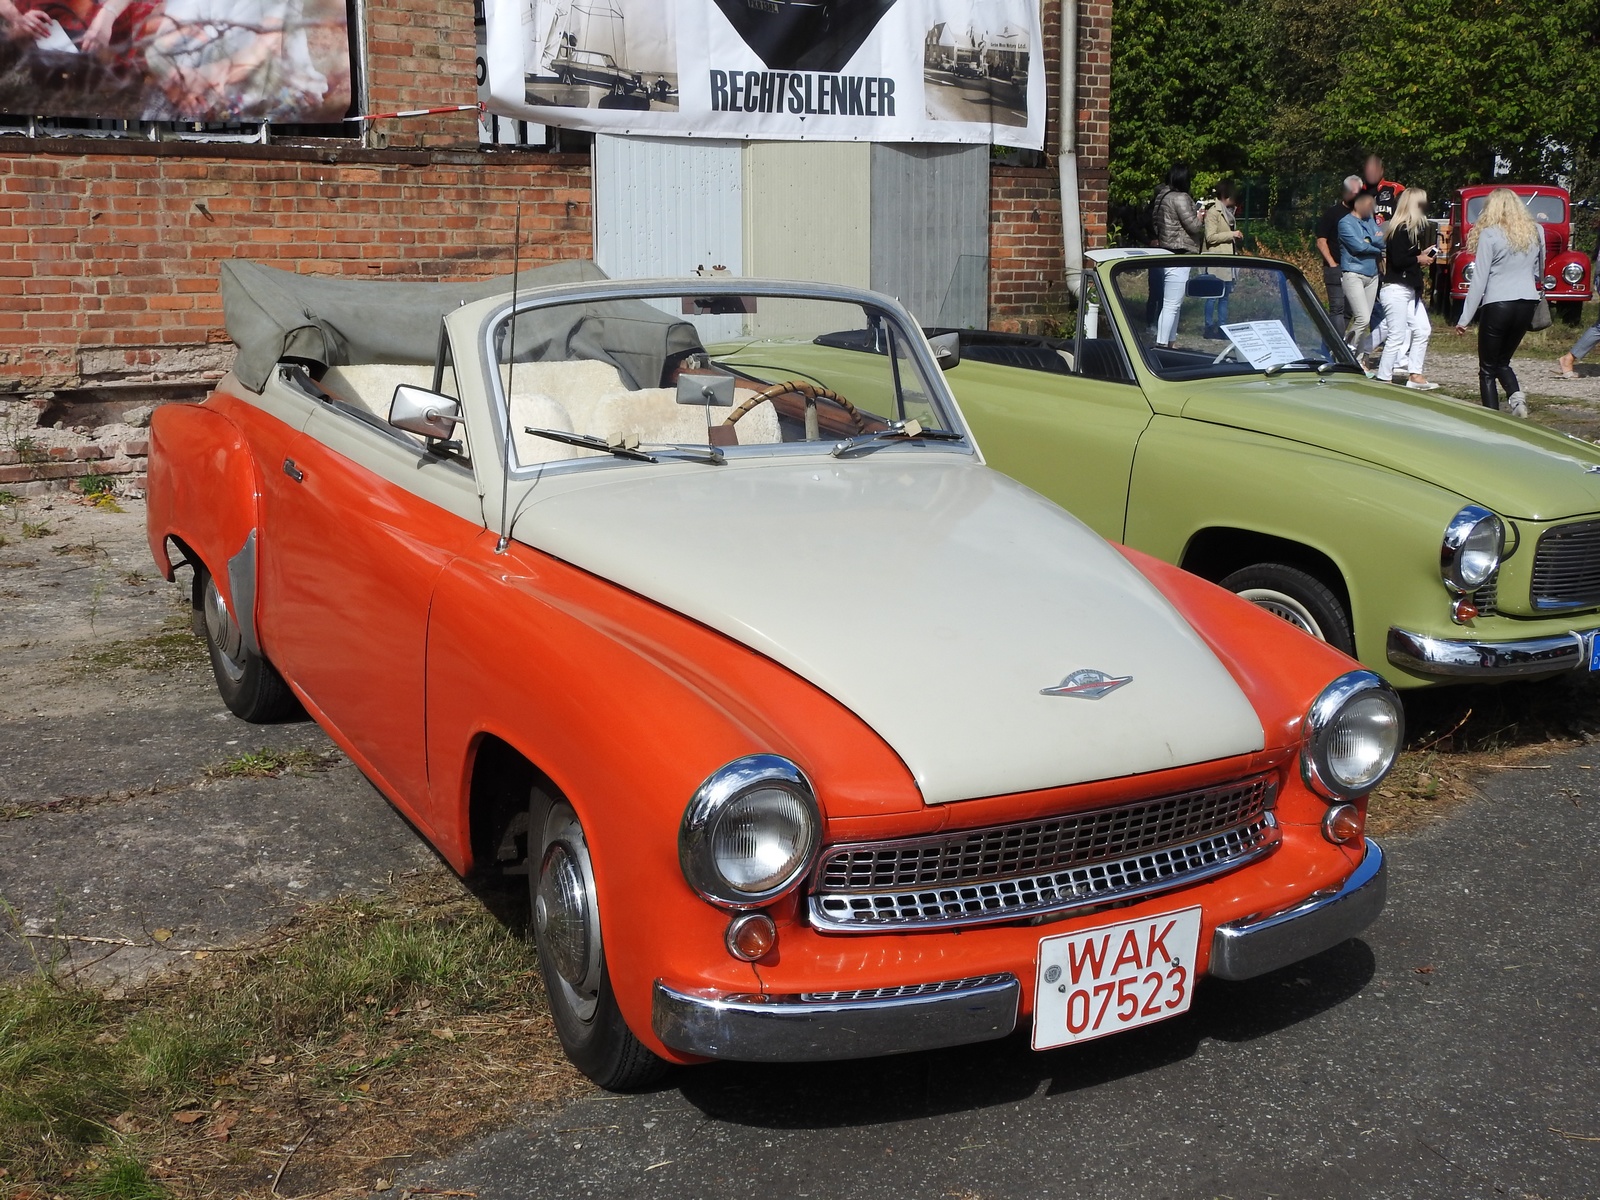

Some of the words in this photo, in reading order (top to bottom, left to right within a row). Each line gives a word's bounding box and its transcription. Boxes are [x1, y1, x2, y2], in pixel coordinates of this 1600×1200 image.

[709, 69, 896, 117] RECHTSLENKER
[1068, 920, 1177, 985] WAK
[1066, 965, 1187, 1035] 07523
